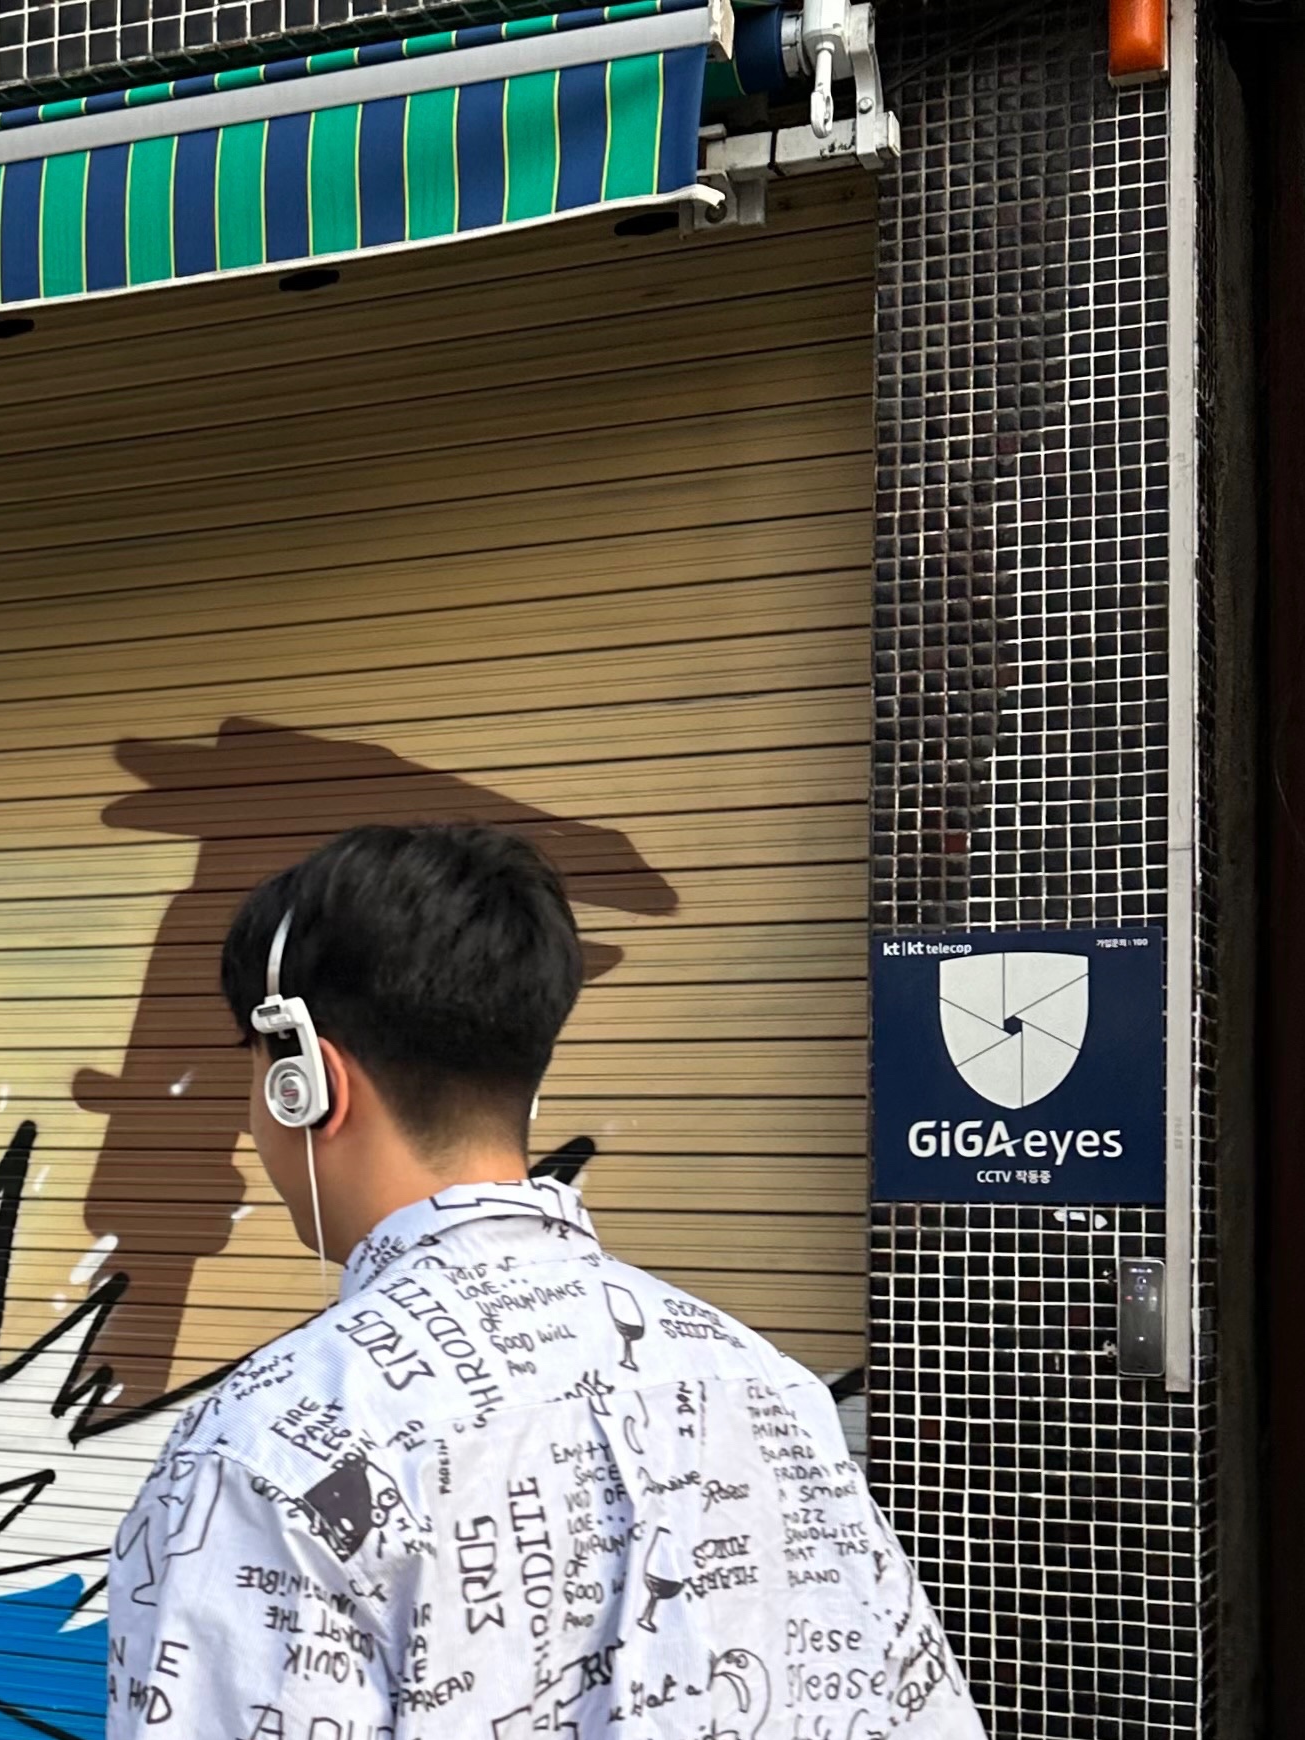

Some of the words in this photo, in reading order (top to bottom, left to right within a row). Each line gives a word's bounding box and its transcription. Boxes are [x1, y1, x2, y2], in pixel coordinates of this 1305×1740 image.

[926, 943, 972, 956] telecop
[977, 1170, 1012, 1183] CCTV
[1015, 1169, 1052, 1184] 작동중
